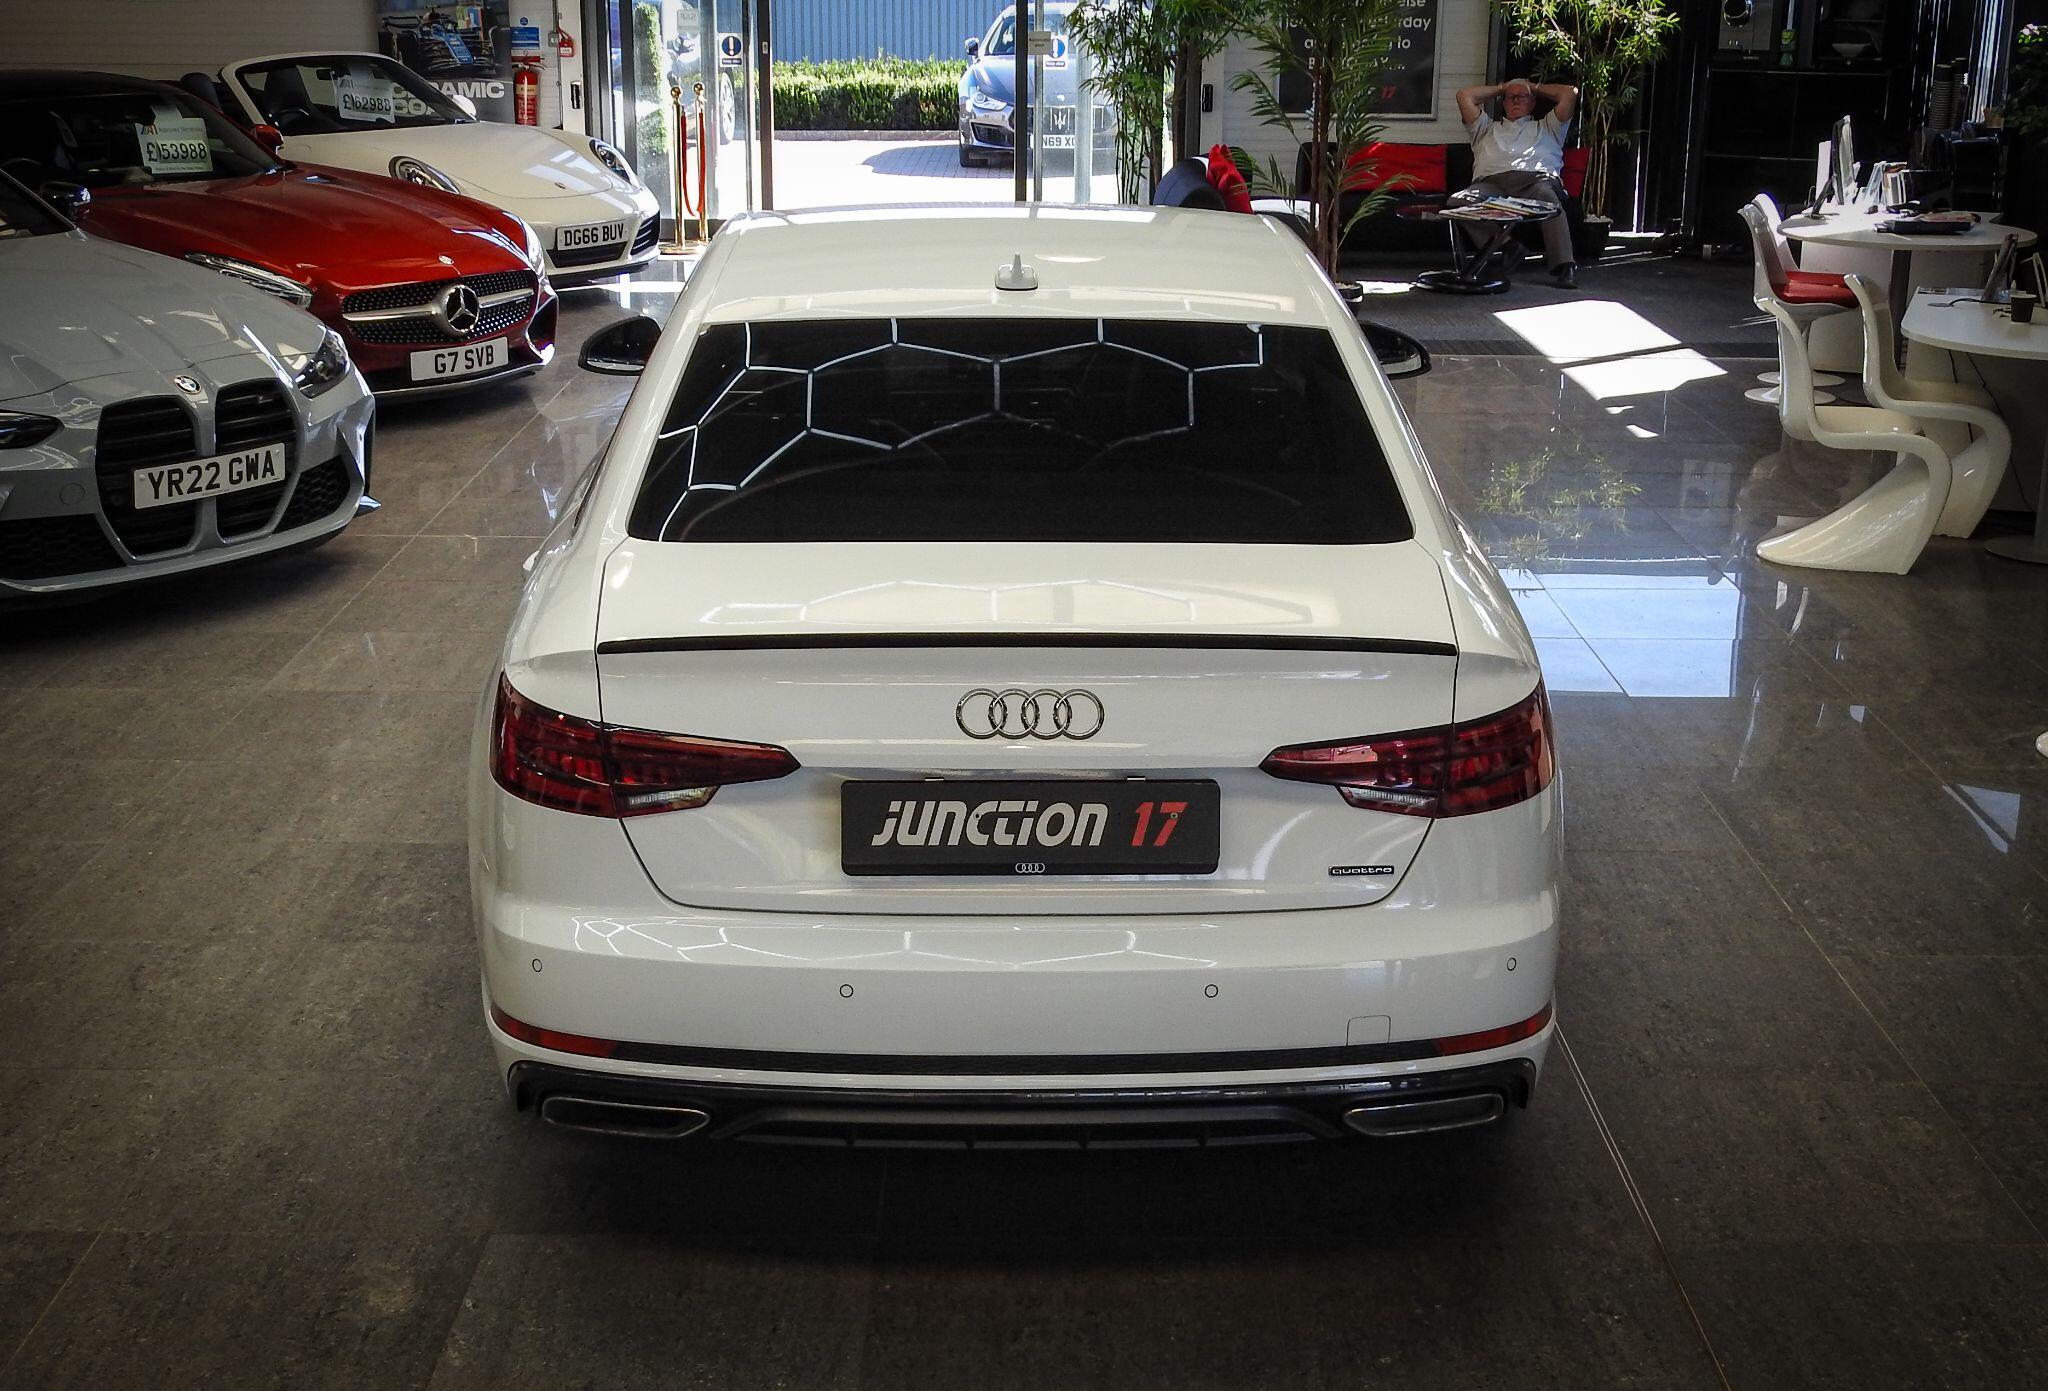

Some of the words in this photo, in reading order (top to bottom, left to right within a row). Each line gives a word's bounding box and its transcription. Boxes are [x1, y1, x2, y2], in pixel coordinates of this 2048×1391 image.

[564, 227, 599, 246] DG66
[602, 223, 624, 242] BUV
[434, 352, 458, 374] G7
[464, 345, 494, 369] SVB
[148, 462, 220, 499] YR22
[228, 450, 275, 485] GWA
[1131, 802, 1188, 847] 17
[1331, 867, 1392, 875] quattro
